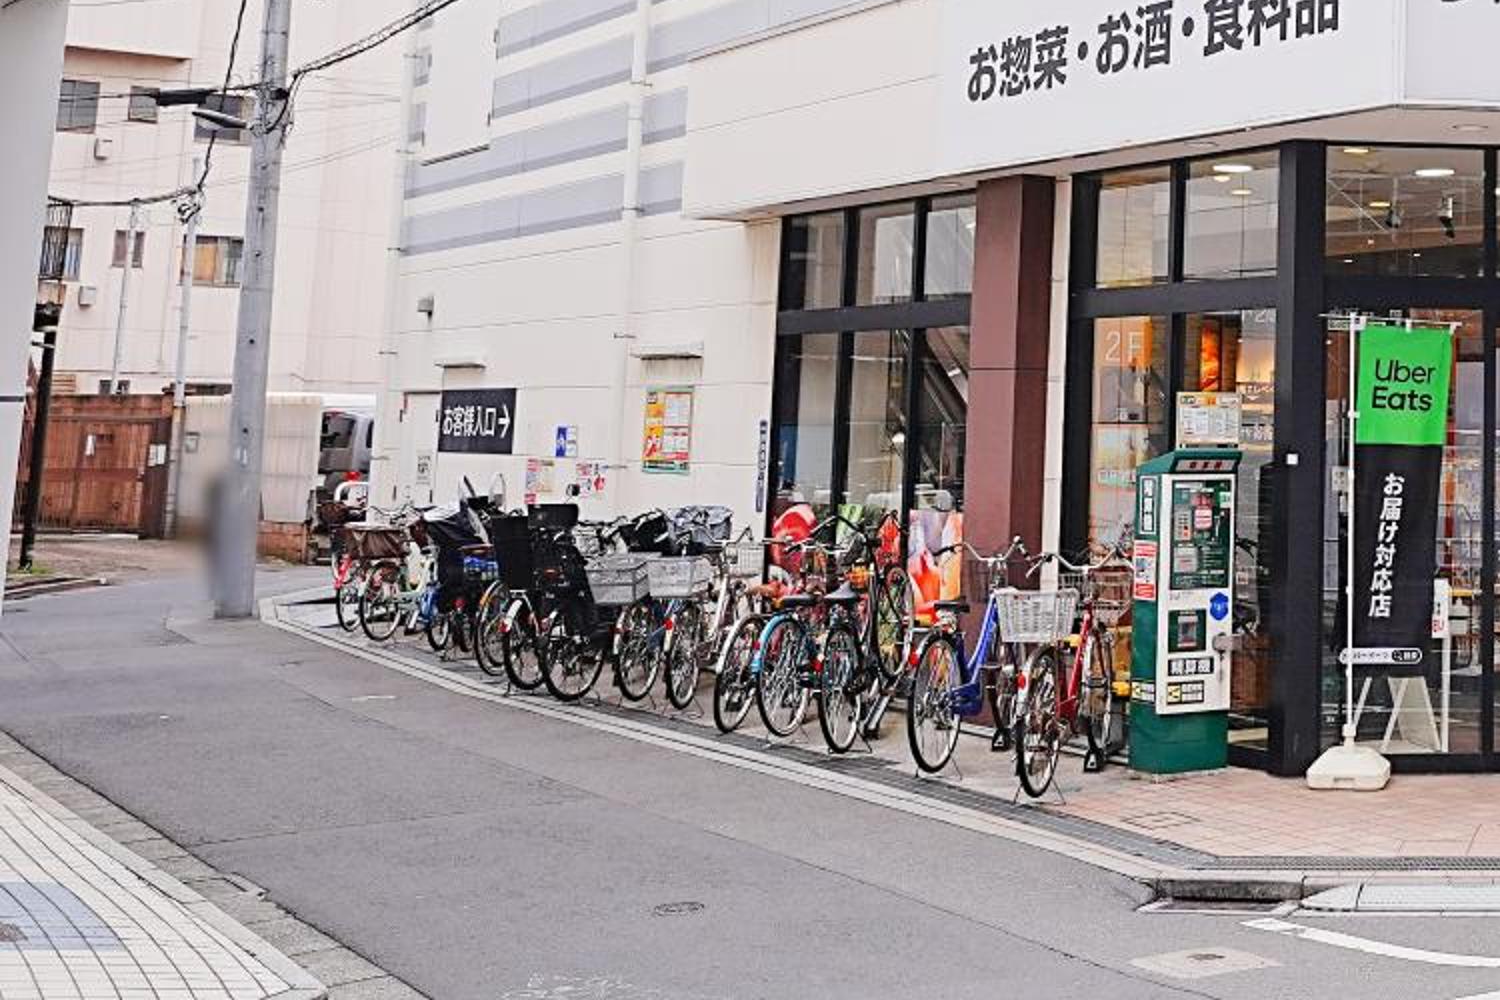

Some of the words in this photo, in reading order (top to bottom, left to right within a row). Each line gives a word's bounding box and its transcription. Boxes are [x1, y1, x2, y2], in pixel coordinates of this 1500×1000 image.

[1104, 330, 1145, 364] 2F
[1374, 359, 1437, 385] Uber
[1371, 386, 1433, 412] Eats
[442, 404, 497, 437] お客様入口
[1368, 471, 1405, 618] お届け対応店
